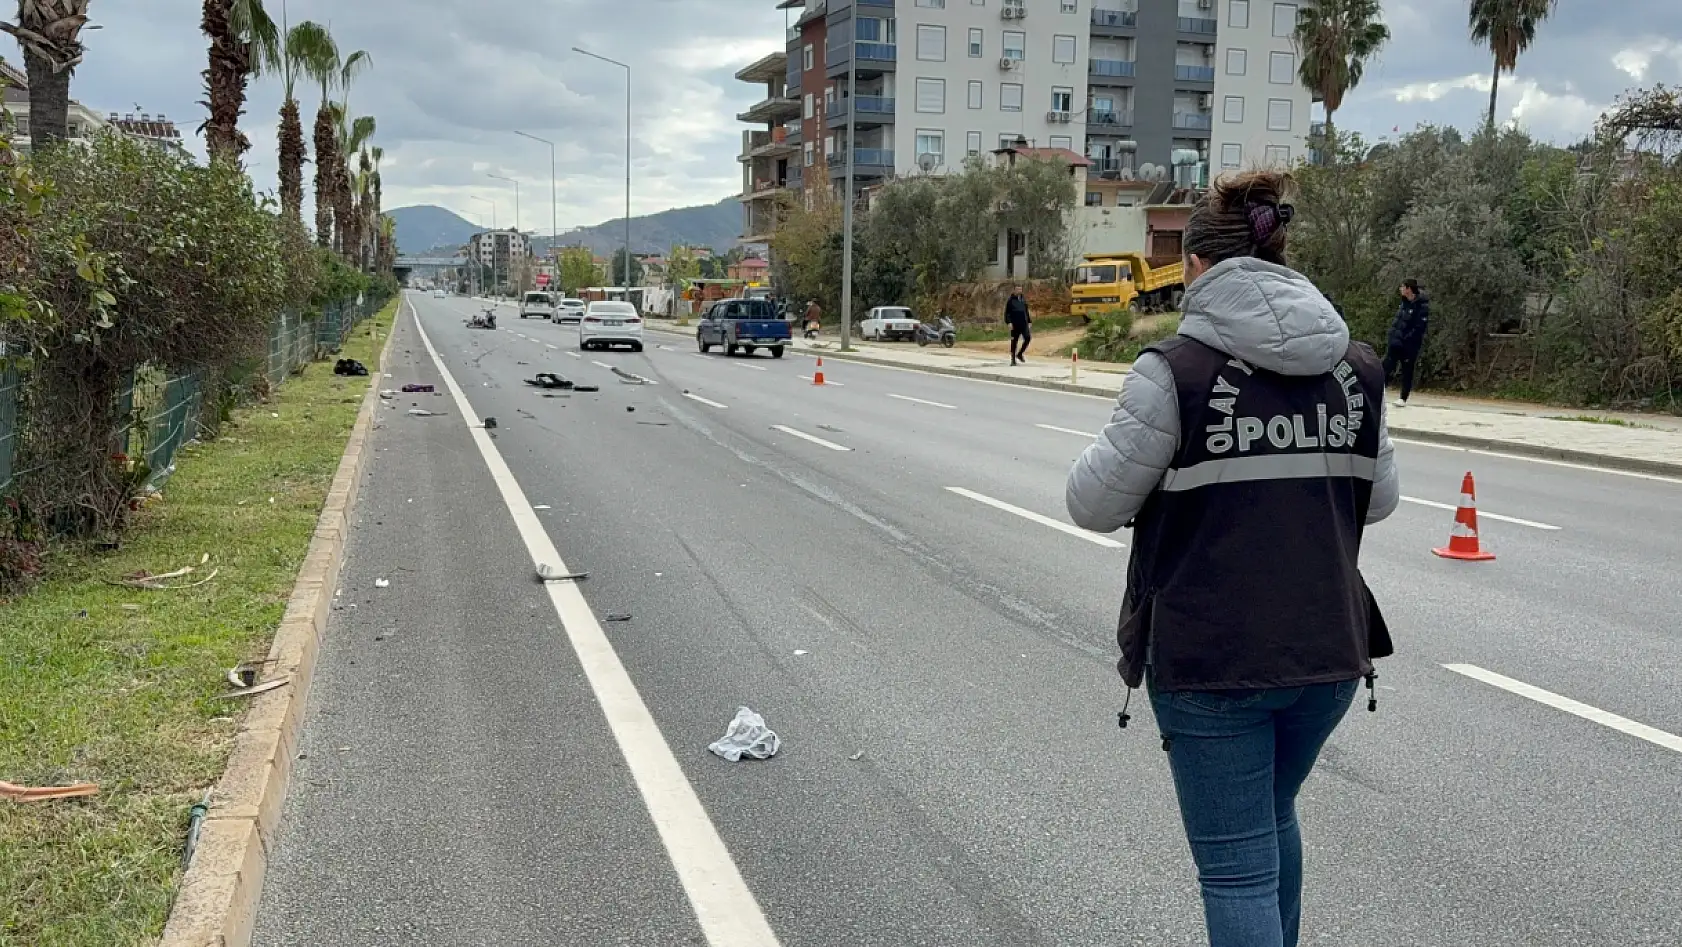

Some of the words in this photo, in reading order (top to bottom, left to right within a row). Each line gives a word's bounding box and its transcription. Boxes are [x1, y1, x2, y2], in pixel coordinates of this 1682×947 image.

[1206, 375, 1240, 453] OLAY
[1332, 359, 1364, 448] ELEM
[1236, 403, 1348, 452] POLİS
